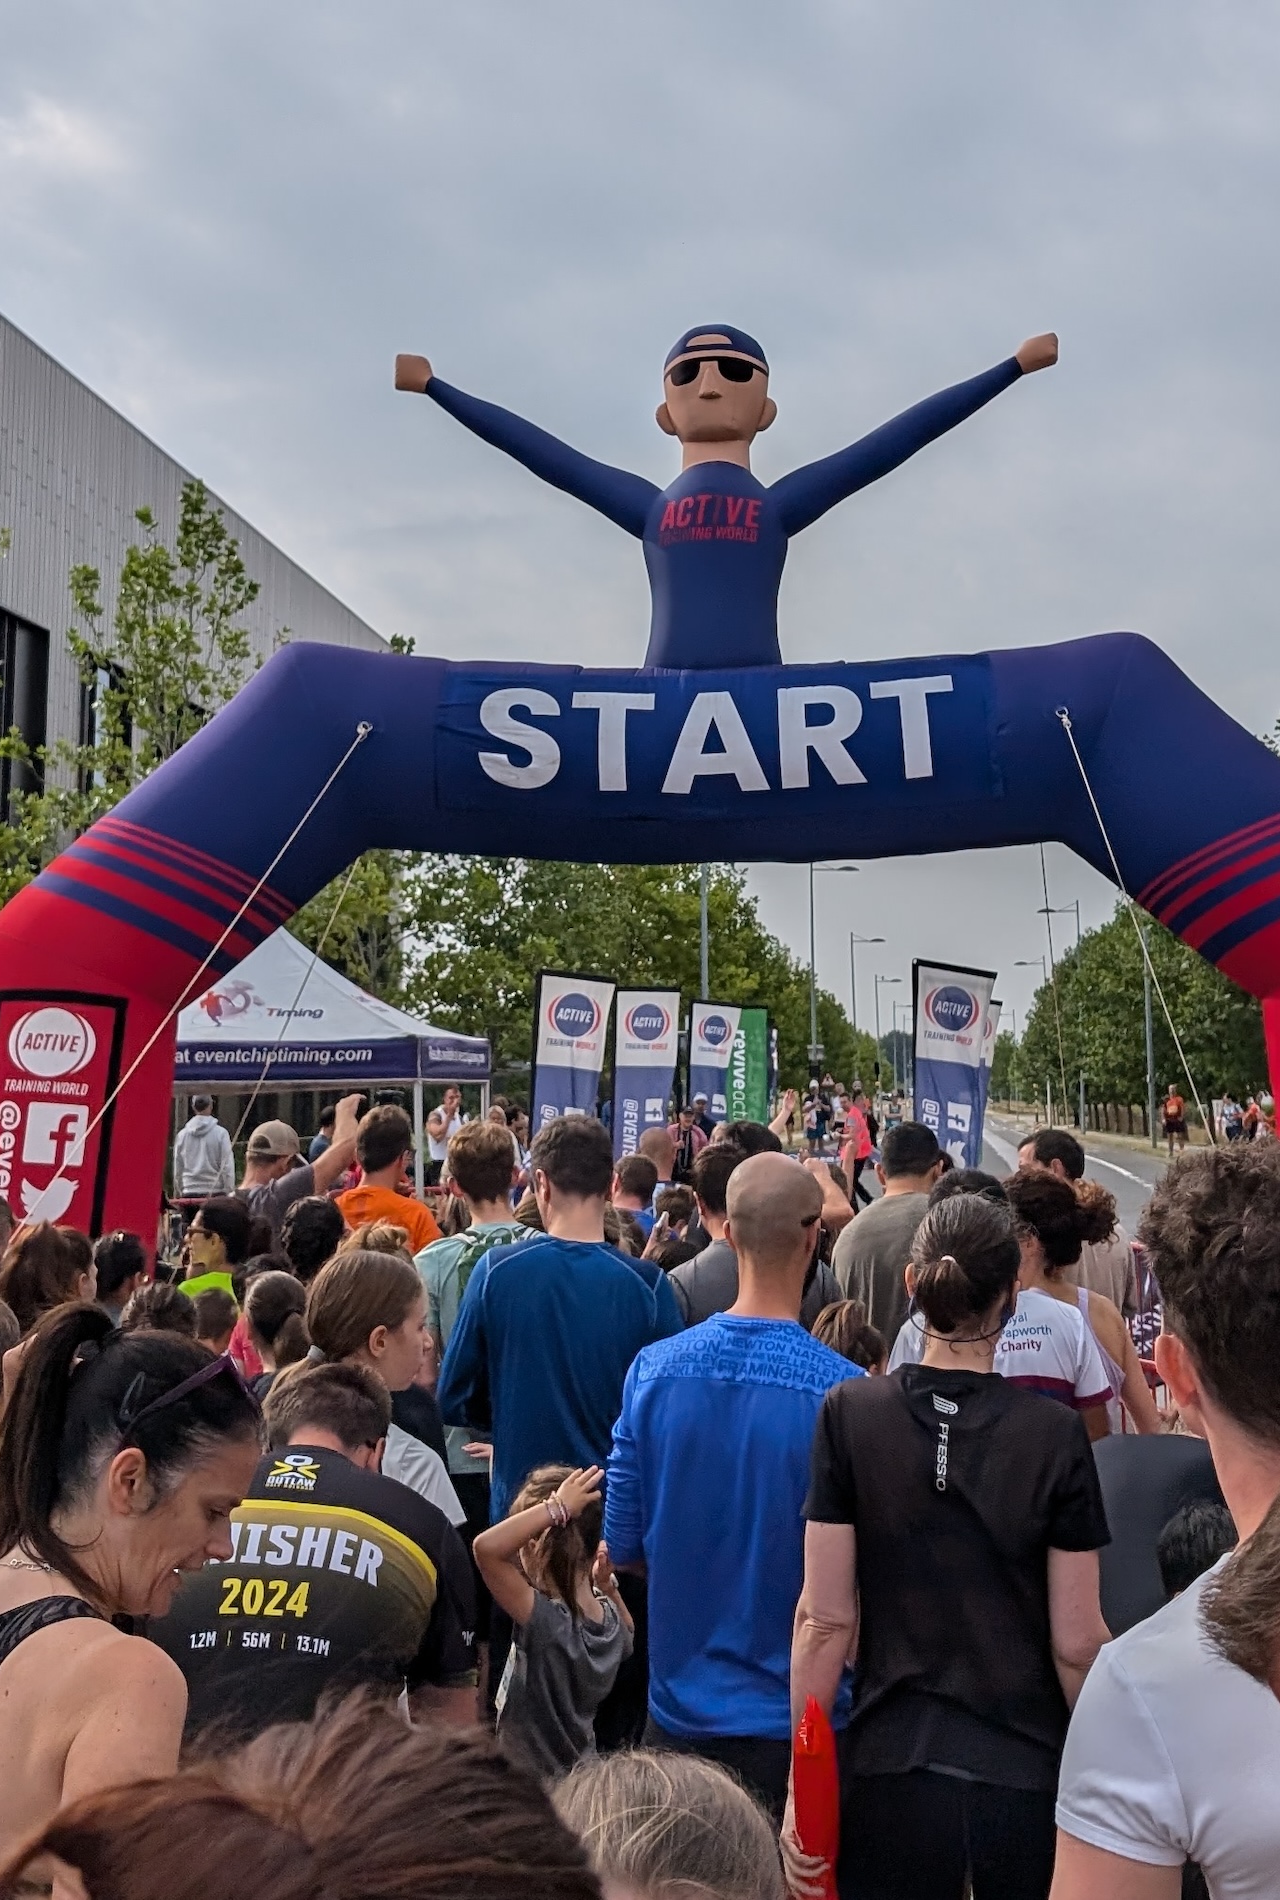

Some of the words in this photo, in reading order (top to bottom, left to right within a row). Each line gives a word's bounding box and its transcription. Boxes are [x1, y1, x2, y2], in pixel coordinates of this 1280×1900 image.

[660, 494, 763, 531] ACTIVE
[716, 526, 758, 543] WORLD
[477, 675, 954, 795] START
[266, 1007, 324, 1020] Timing
[557, 1007, 594, 1024] ACTIVE
[934, 1000, 971, 1019] ACTIVE
[632, 1016, 663, 1029] ACTIVE
[23, 1032, 82, 1053] ACTIVE
[923, 1030, 955, 1042] TRAINING
[174, 1049, 190, 1062] at
[195, 1047, 373, 1065] eventchiptiming.com
[4, 1078, 51, 1093] TRAINING
[52, 1081, 90, 1096] WORLD
[655, 1339, 721, 1358] BOSTON
[726, 1337, 786, 1353] NEWTON
[789, 1346, 840, 1370] NATICK
[1001, 1338, 1042, 1352] Charity
[767, 1352, 838, 1380] WELLESLEY
[266, 1475, 316, 1488] OUTLAW
[218, 1578, 311, 1618] 2024
[190, 1630, 217, 1649] 1.2M
[242, 1631, 271, 1649] 56M
[297, 1635, 330, 1657] 13.1M
